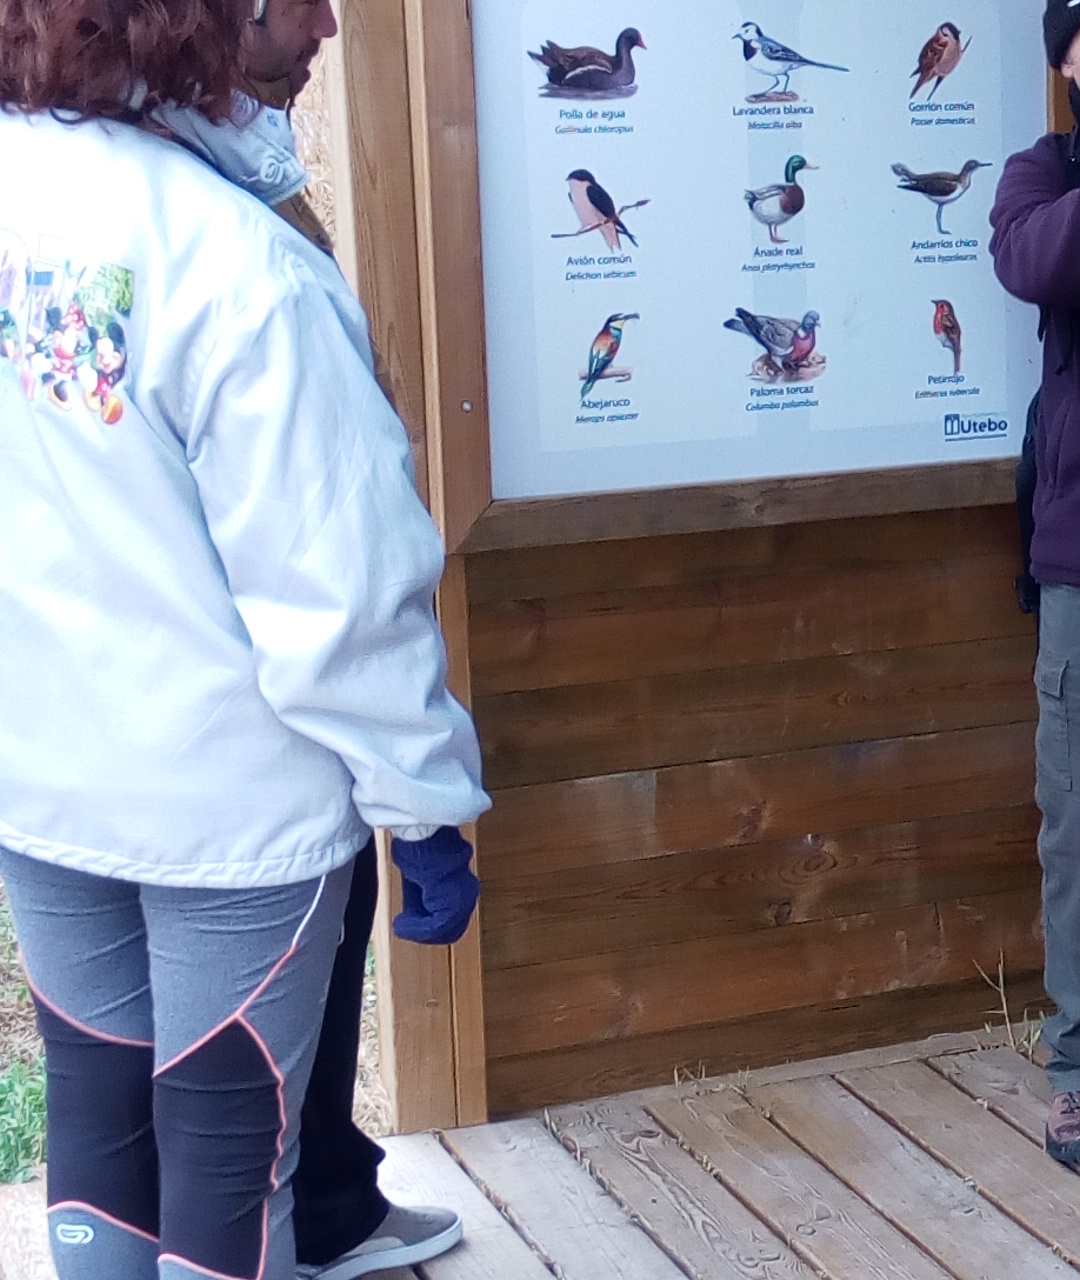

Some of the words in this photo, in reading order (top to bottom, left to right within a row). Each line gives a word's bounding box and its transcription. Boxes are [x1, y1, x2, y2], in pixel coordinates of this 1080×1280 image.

[585, 108, 599, 119] de
[600, 110, 626, 121] agua
[732, 105, 782, 116] Lavandera
[783, 104, 814, 115] blanca
[954, 238, 978, 248] chico
[785, 245, 804, 256] real
[749, 386, 785, 397] Paloma
[786, 385, 815, 395] torcaz
[580, 398, 631, 410] Abejaruco
[960, 417, 1008, 434] Utebo
